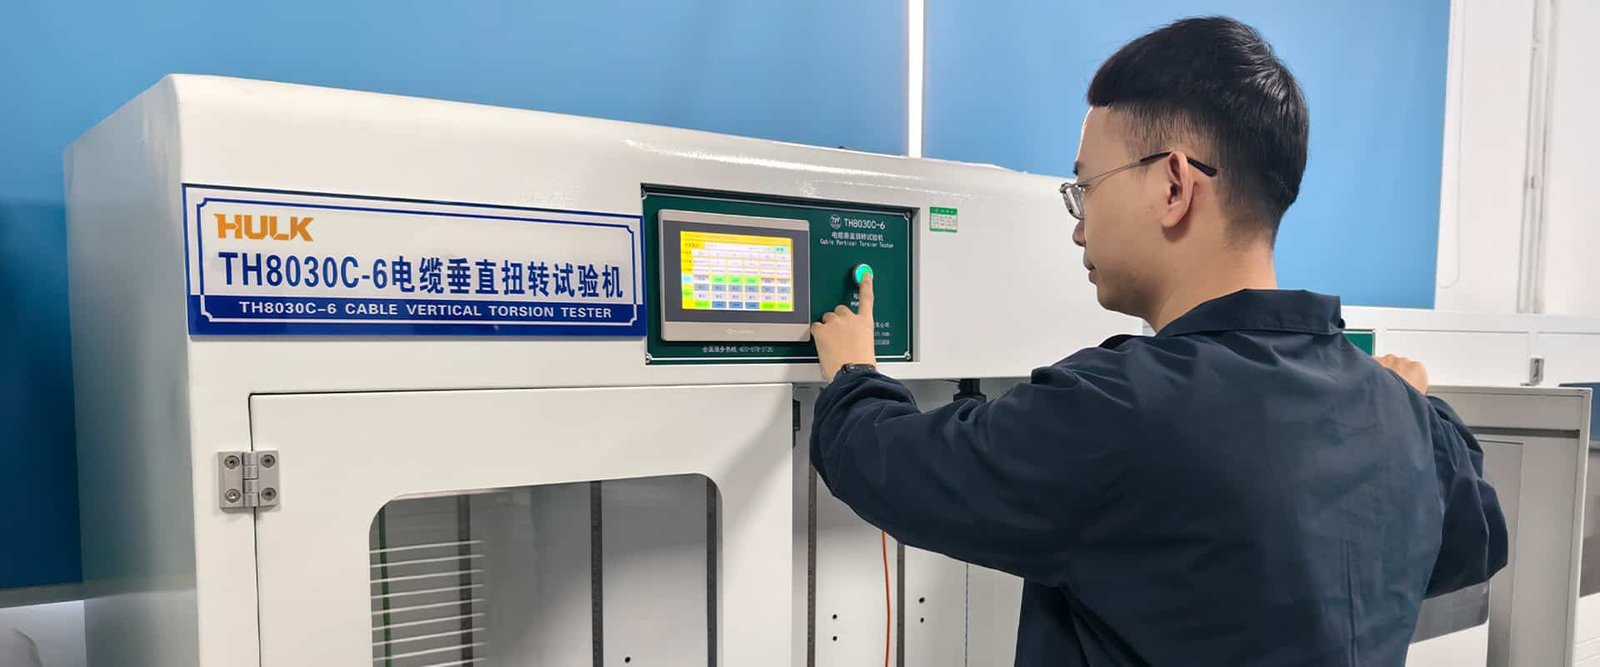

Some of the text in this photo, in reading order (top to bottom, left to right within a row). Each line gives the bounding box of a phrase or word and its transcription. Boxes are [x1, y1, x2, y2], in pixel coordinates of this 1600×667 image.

[214, 213, 314, 242] HULK
[239, 300, 612, 319] TH8030C-6 CABLE VERTICAL TORSION TESTER
